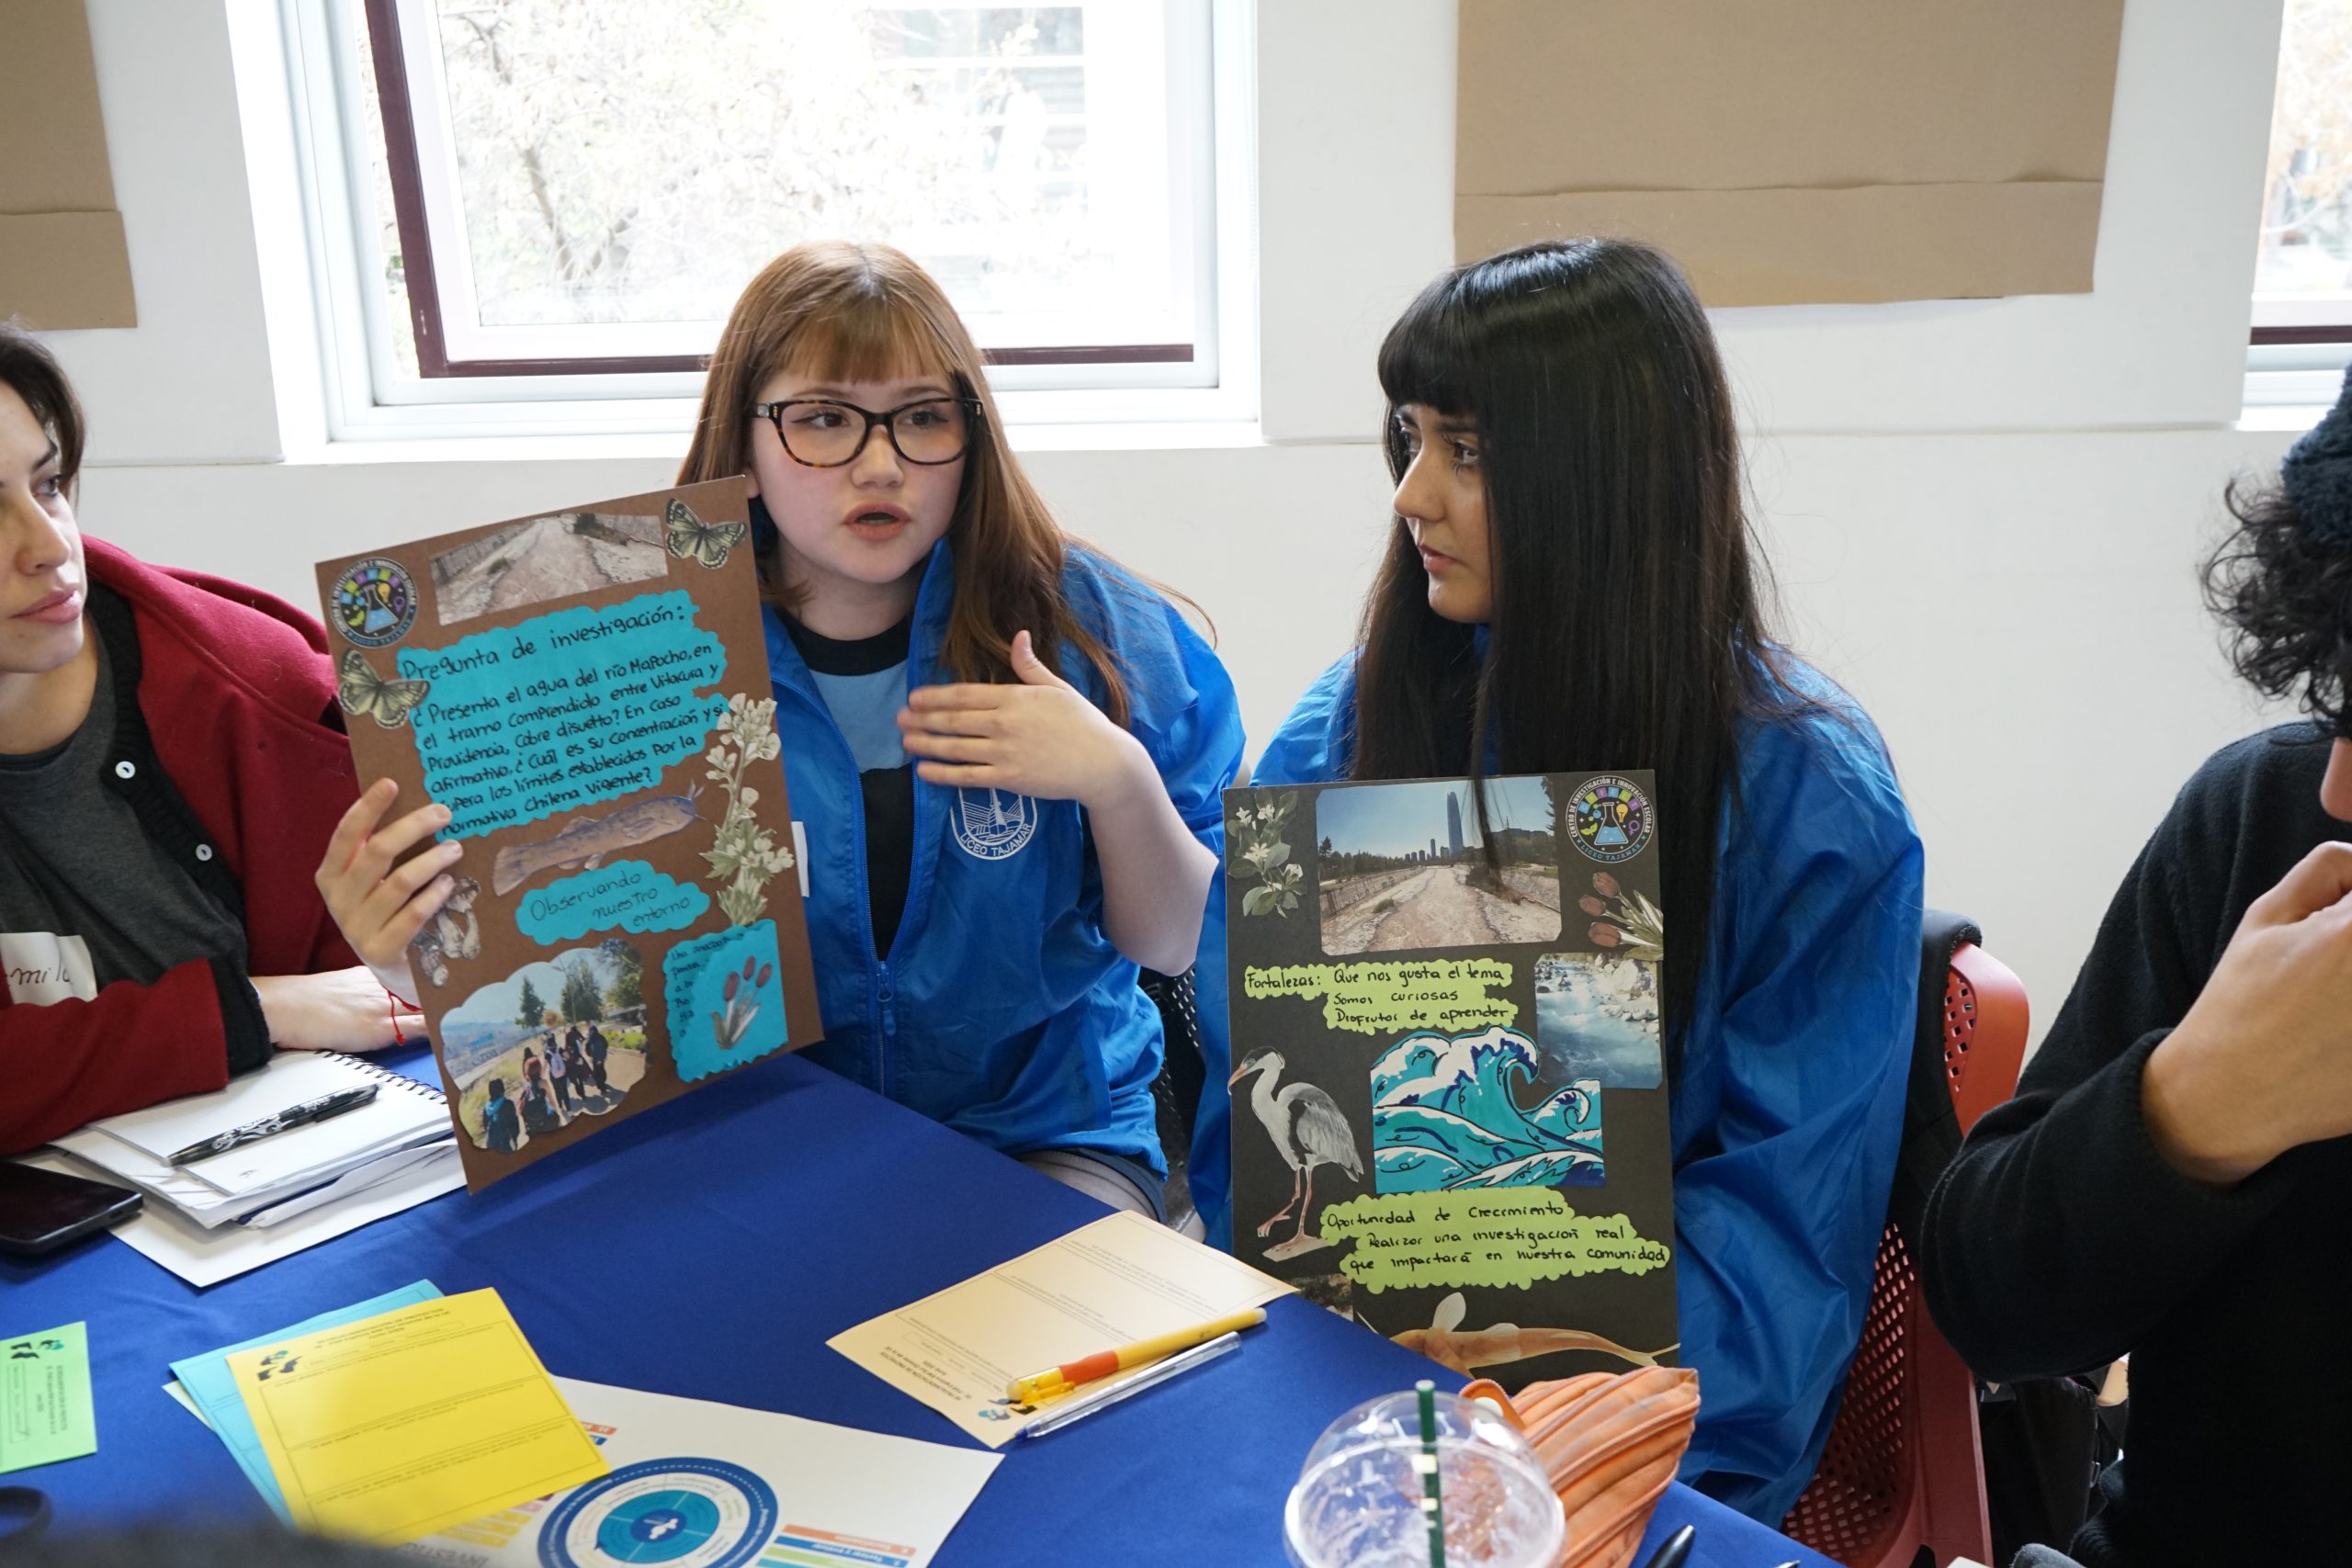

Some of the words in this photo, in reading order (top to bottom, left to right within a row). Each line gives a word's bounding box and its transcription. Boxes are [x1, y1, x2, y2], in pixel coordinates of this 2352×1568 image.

[402, 649, 500, 681] Pregunta
[512, 636, 537, 660] de
[550, 604, 685, 649] investigación:
[506, 686, 523, 704] el
[526, 677, 569, 697] agua
[575, 668, 598, 688] del
[694, 644, 713, 658] en
[423, 733, 438, 750] el
[448, 720, 502, 743] tramo
[610, 682, 648, 702] entre
[709, 664, 718, 680] y
[625, 705, 645, 720] En
[566, 743, 584, 758] es
[703, 707, 711, 723] y
[490, 786, 513, 802] los
[679, 736, 696, 749] la
[1572, 777, 1611, 806] INVESTIGACIÓN
[1568, 805, 1577, 814] DE
[959, 831, 989, 855] LICEO
[990, 822, 1032, 857] TAJAMAR
[1567, 814, 1578, 839] CENTRO
[1580, 844, 1602, 860] LICEO
[530, 870, 642, 921] Observando
[592, 887, 659, 919] nuestro
[632, 897, 690, 927] entorno
[1247, 972, 1322, 989] Fortalezas:
[1333, 968, 1359, 985] Que
[1367, 971, 1391, 982] nos
[1398, 965, 1442, 987] gusta
[1448, 969, 1461, 979] el
[1466, 964, 1506, 980] tema
[1333, 993, 1374, 1006] Somos
[1391, 990, 1459, 1002] curiosas
[1409, 1010, 1428, 1021] de
[1440, 1007, 1510, 1025] aprender
[1327, 1209, 1416, 1232] Oportunidad
[1433, 1206, 1451, 1223] de
[1434, 1232, 1462, 1245] una
[1473, 1227, 1579, 1249] investigación
[1595, 1225, 1625, 1240] real
[1349, 1258, 1374, 1274] que
[1392, 1251, 1473, 1272] impactará
[1486, 1250, 1503, 1261] en
[1516, 1245, 1576, 1261] nuestra
